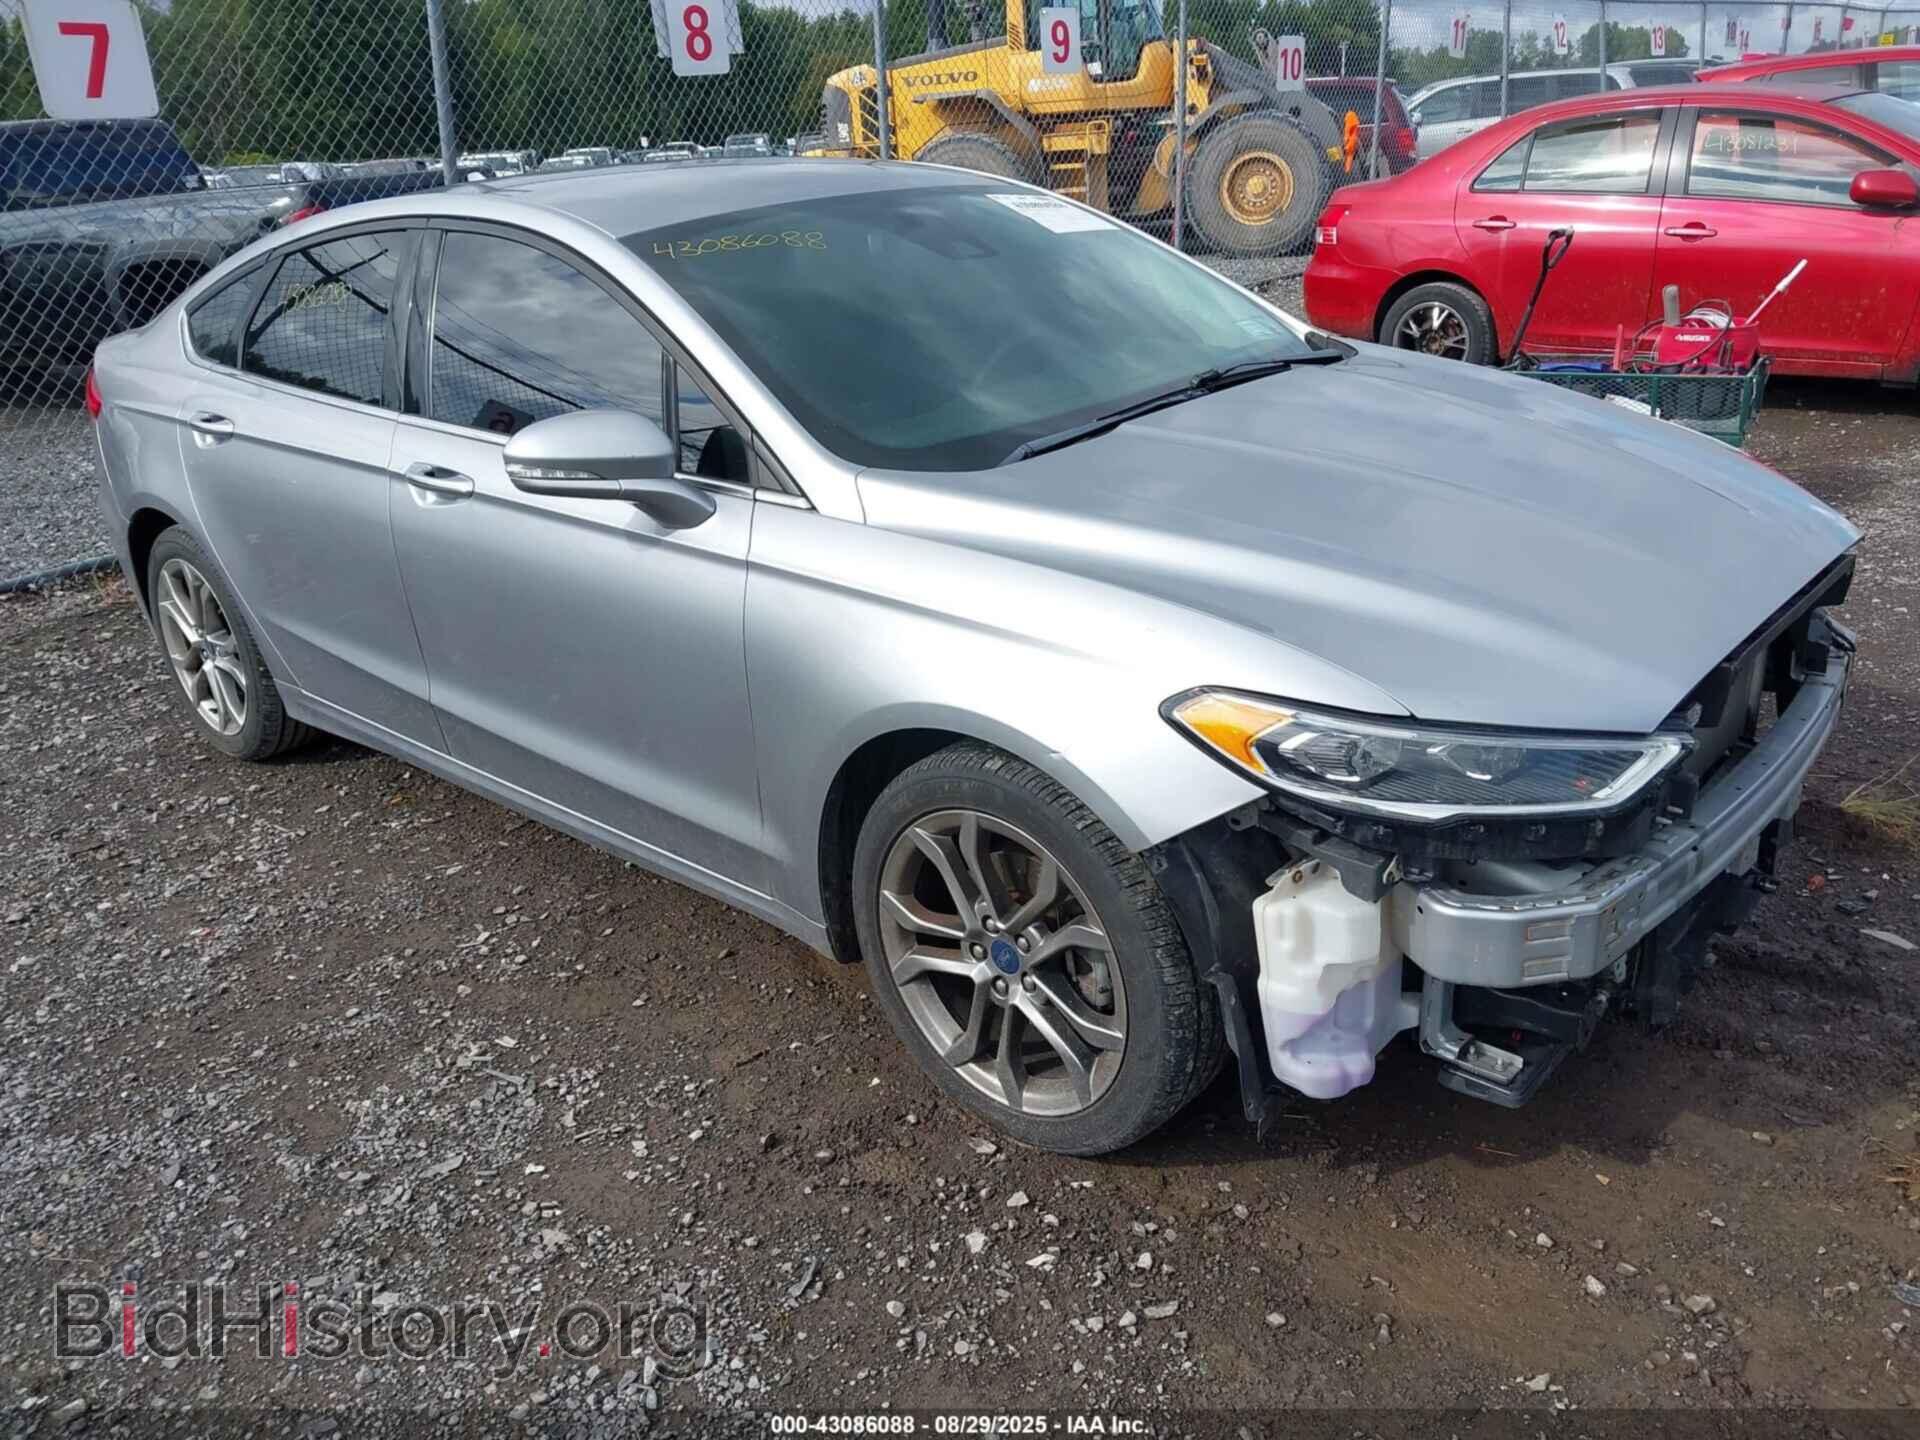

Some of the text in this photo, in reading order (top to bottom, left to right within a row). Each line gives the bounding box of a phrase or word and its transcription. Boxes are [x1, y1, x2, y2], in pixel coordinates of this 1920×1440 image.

[683, 5, 712, 61] 8
[1051, 20, 1070, 63] 9
[1453, 18, 1467, 49] 11
[1555, 22, 1567, 48] 12
[1653, 27, 1664, 49] 13
[58, 22, 109, 98] 7
[1280, 48, 1301, 80] 10
[901, 70, 978, 87] VOLVO
[653, 231, 827, 259] 43086088
